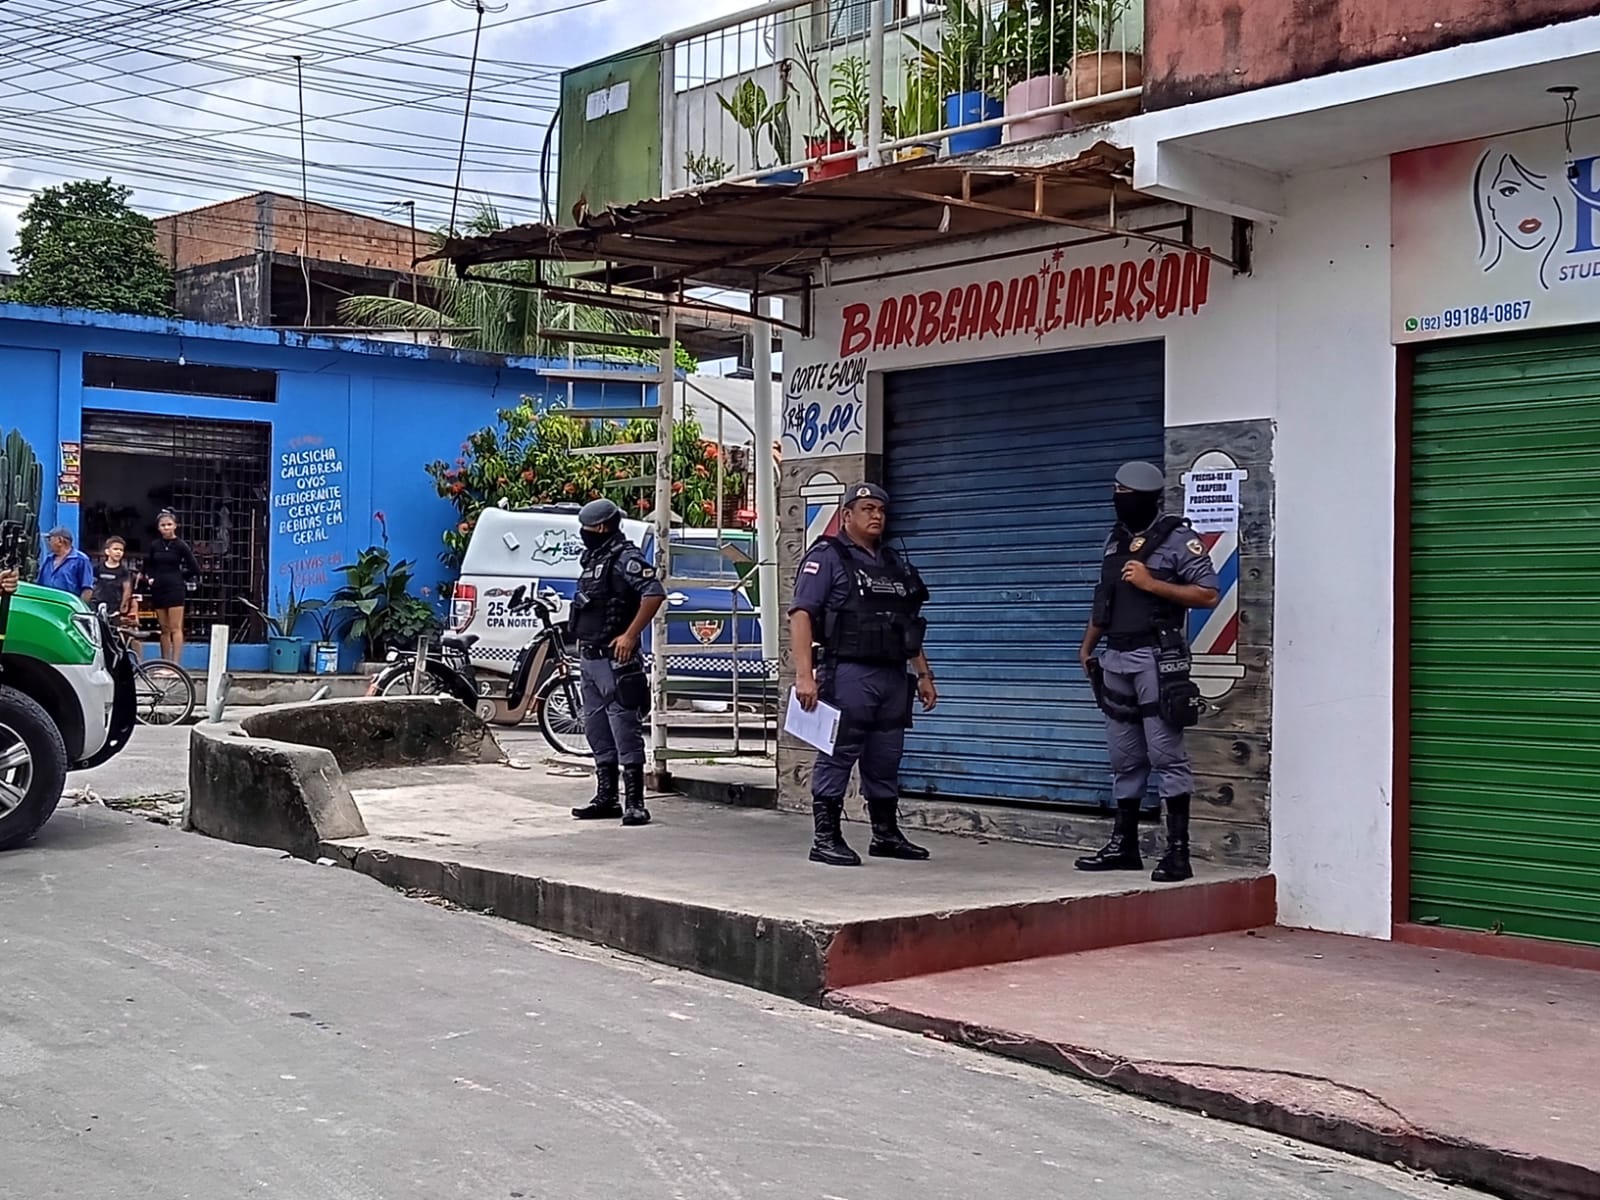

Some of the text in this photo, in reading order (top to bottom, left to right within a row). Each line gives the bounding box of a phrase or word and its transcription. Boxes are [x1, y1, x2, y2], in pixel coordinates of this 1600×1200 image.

[841, 247, 1212, 358] BARBEARIA EMERSON
[1420, 301, 1531, 331] (92) 99184-0867
[790, 358, 867, 394] CORTE SOCIAL
[281, 448, 336, 466] SALSICHA
[281, 461, 343, 478] CALABRESA
[288, 500, 341, 518] CERVEJA
[279, 512, 343, 534] BEBIDAS EM
[293, 528, 329, 545] GERAL
[487, 617, 539, 628] CPA NORTE
